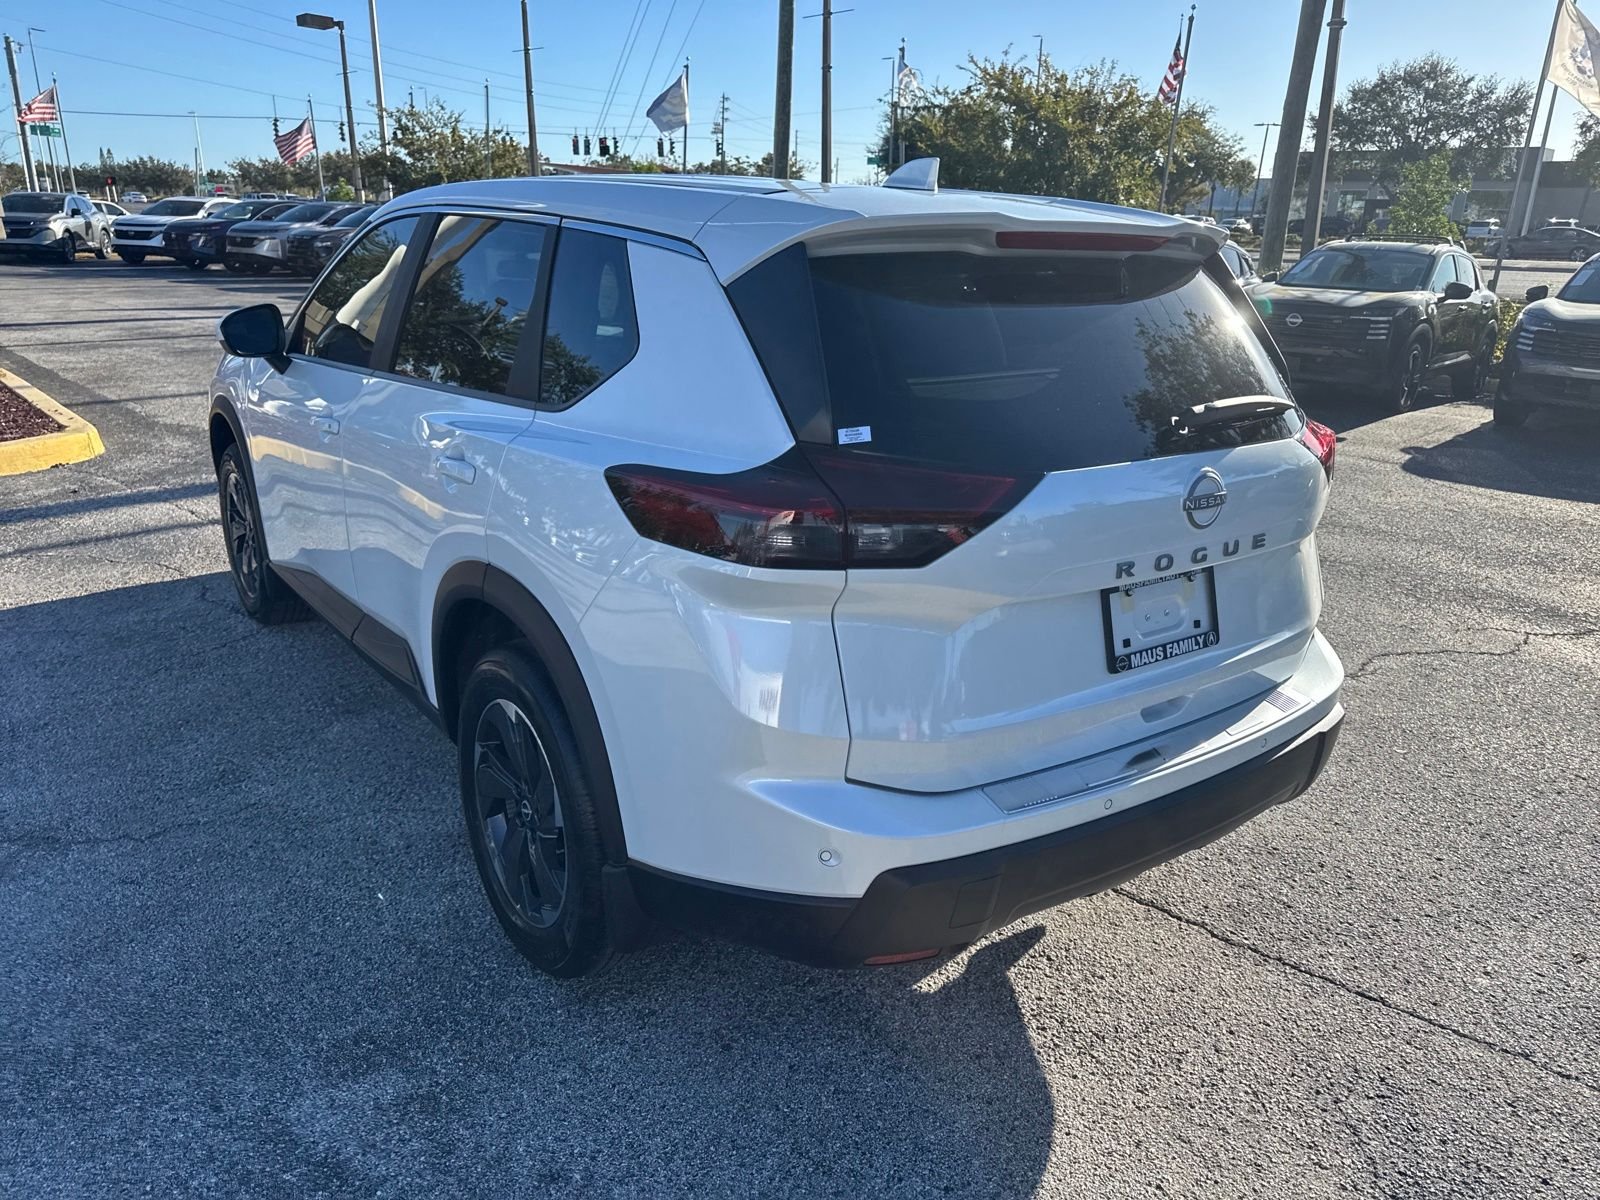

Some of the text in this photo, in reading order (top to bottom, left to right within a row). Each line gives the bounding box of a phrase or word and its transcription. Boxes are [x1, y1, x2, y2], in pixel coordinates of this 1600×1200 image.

[1185, 495, 1227, 510] NISSAN
[1115, 532, 1267, 579] ROGUE
[1130, 634, 1205, 669] MAUS FAMILY
